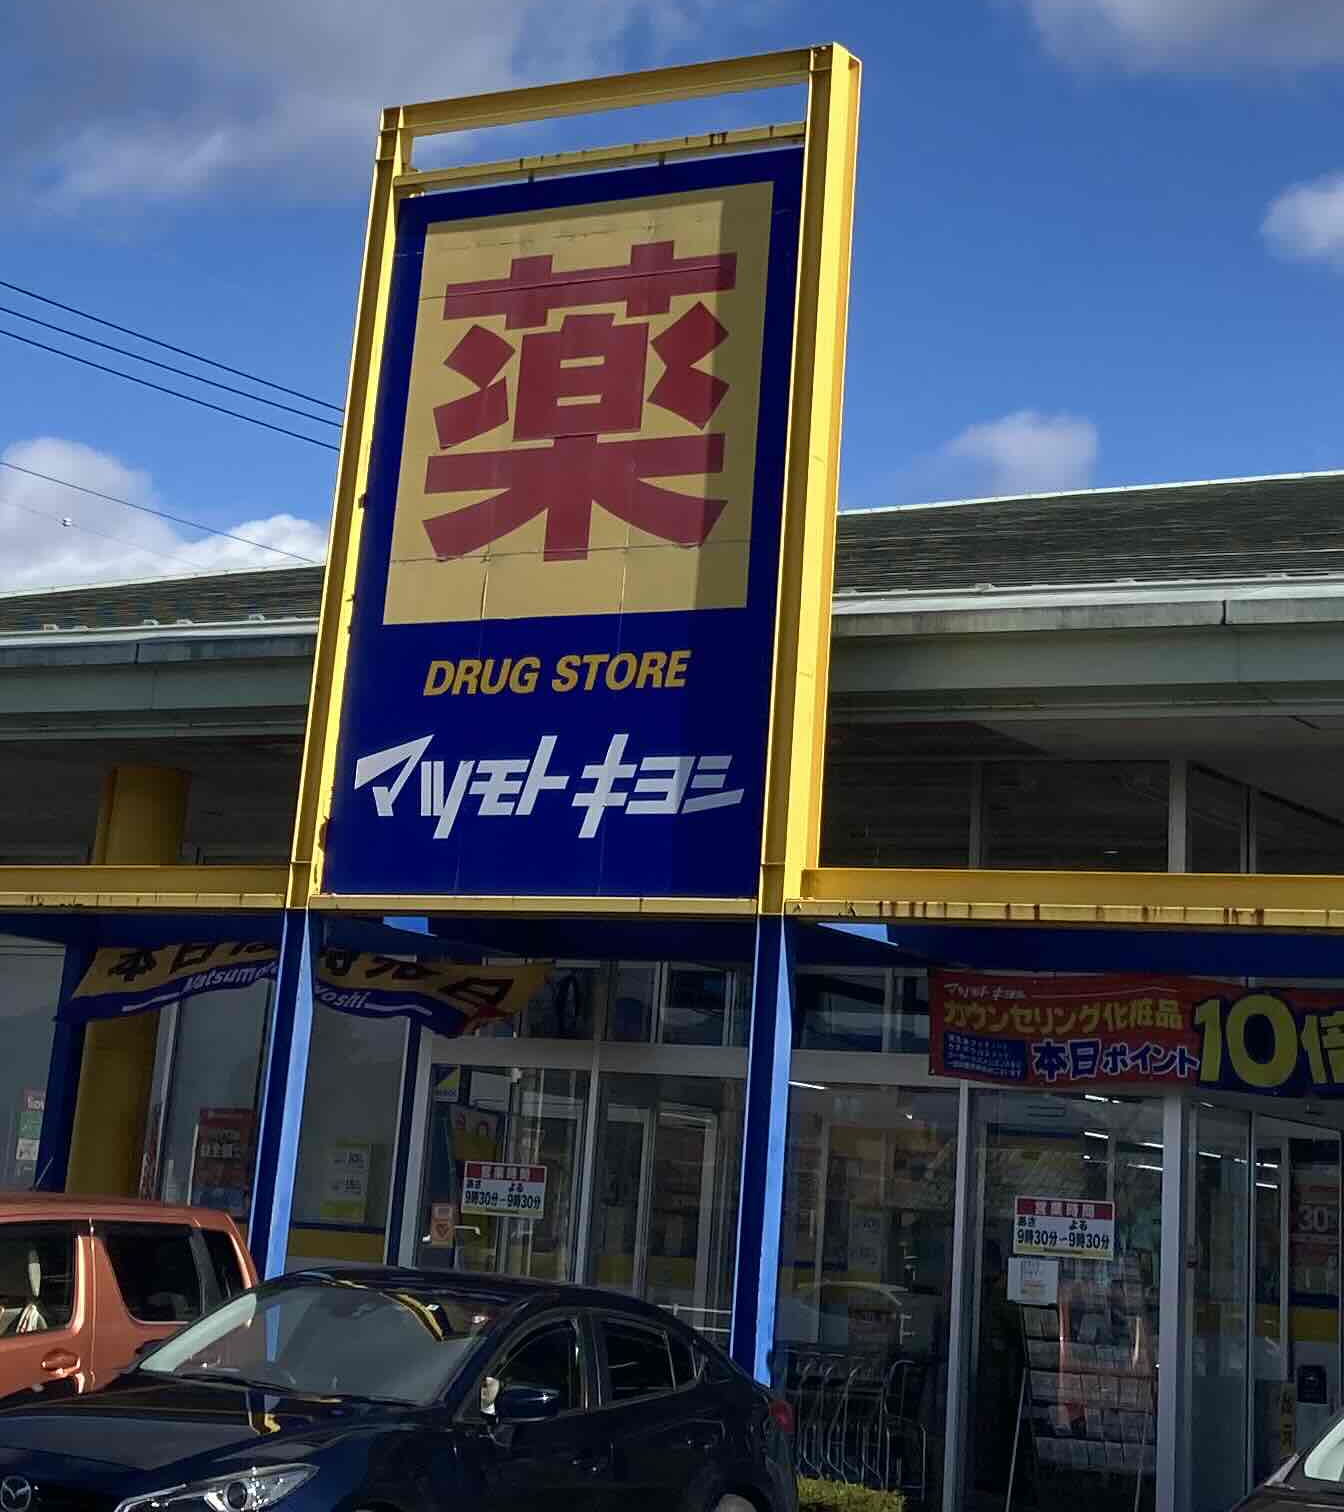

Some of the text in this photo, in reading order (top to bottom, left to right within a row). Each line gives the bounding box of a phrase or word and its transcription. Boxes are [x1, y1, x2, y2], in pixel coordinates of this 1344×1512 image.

[423, 240, 738, 563] 薬
[423, 649, 693, 697] DRUG STORE
[354, 733, 746, 840] マツモトキヨシ
[944, 999, 1184, 1034] カウンセリング化粧品
[1032, 1039, 1201, 1081] 本日ポイント
